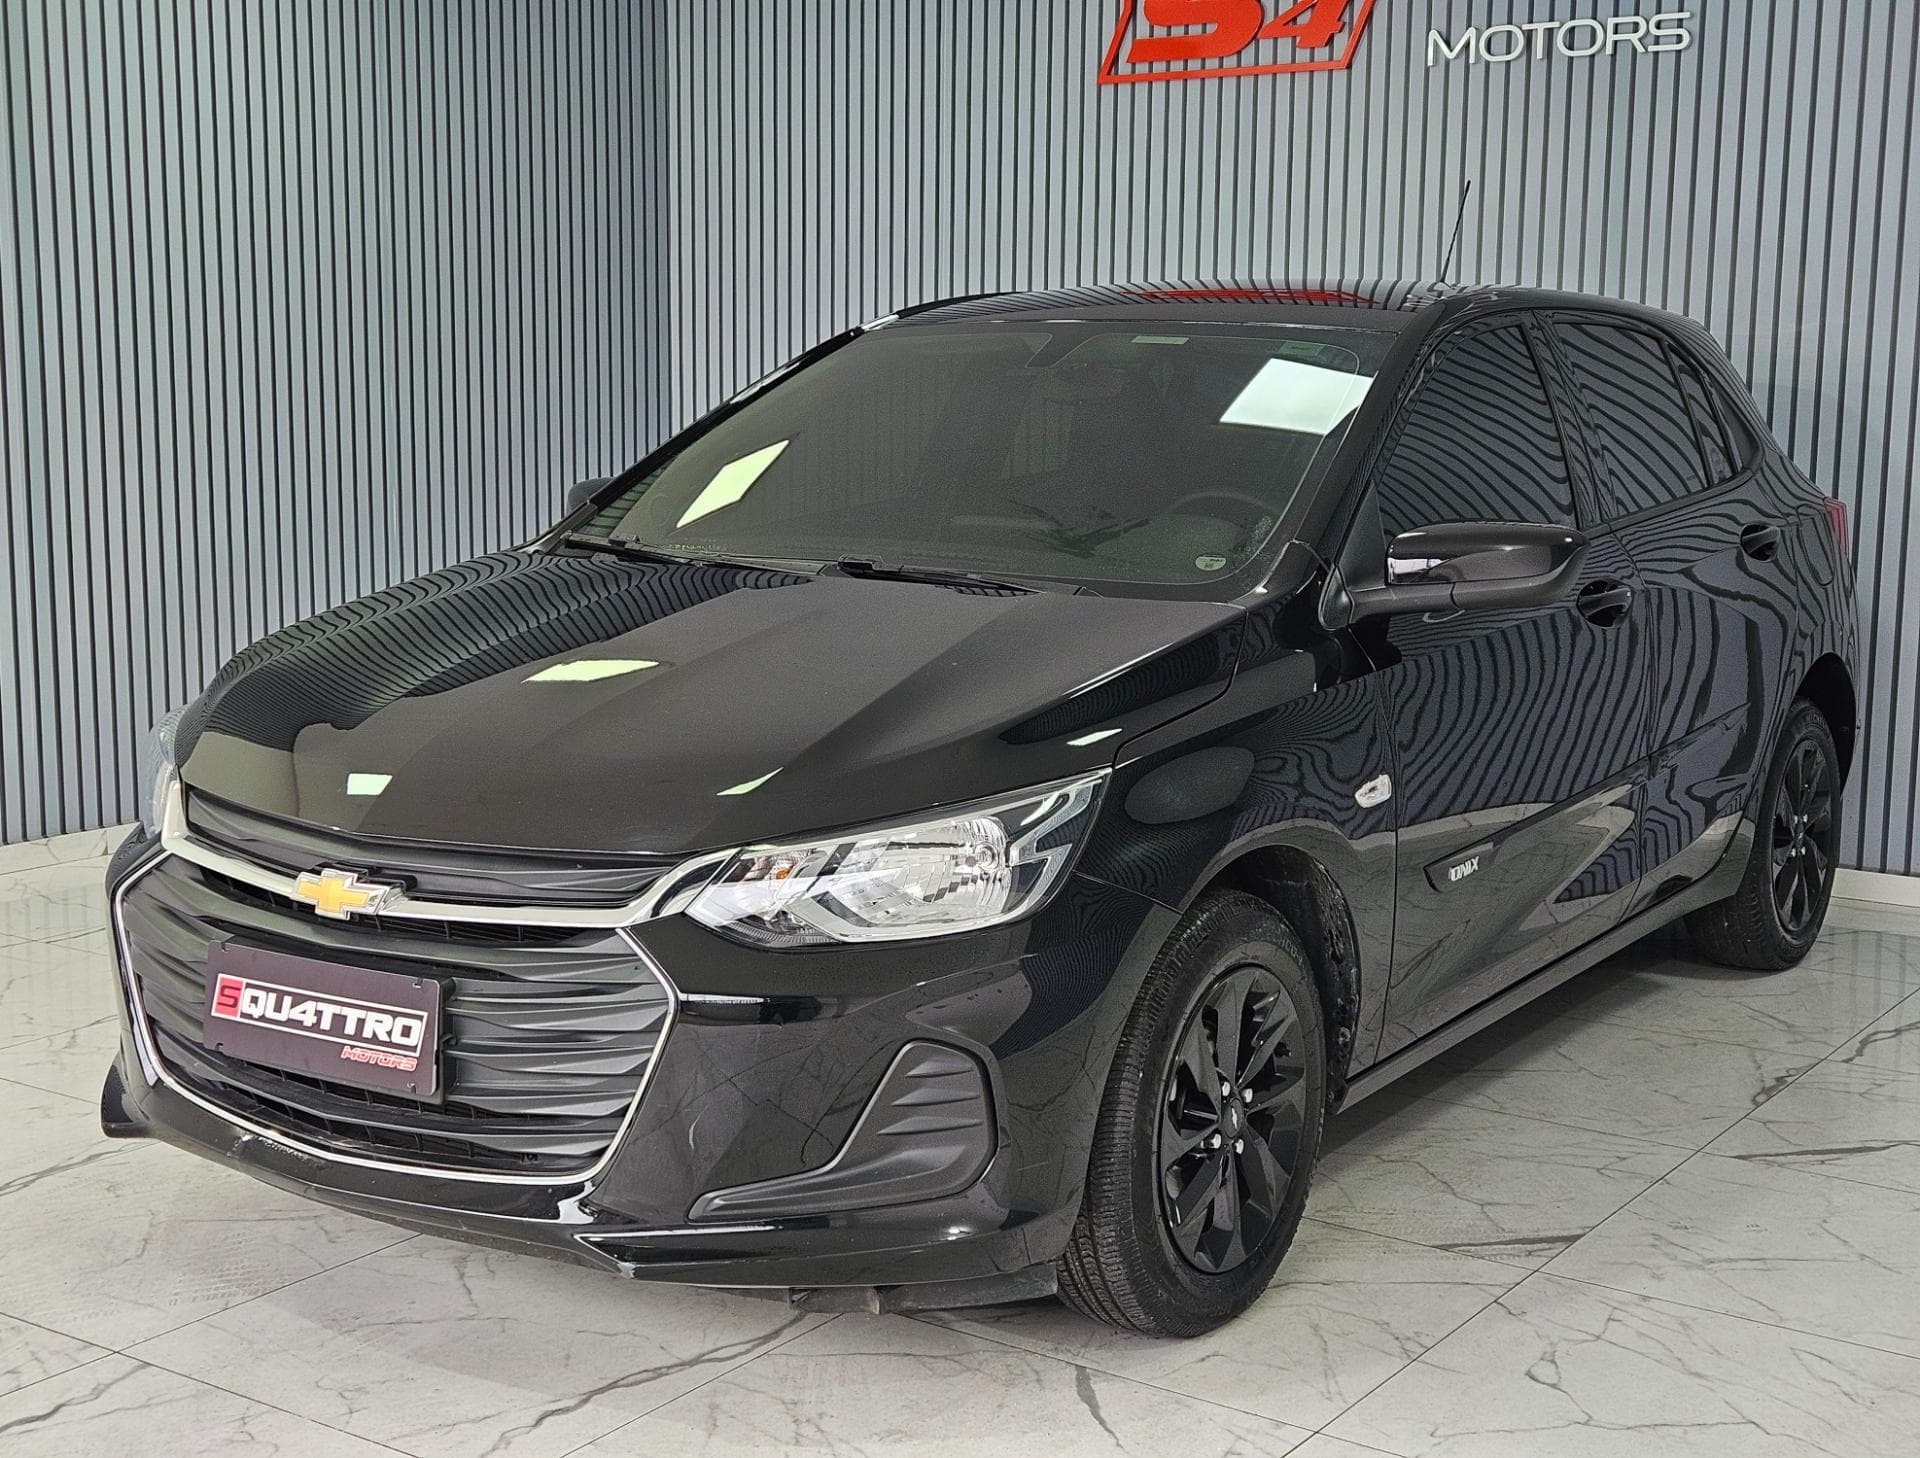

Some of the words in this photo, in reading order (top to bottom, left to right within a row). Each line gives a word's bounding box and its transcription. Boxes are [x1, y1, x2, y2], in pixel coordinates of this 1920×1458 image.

[1427, 11, 1692, 67] MOTORS
[1449, 855, 1479, 882] ONIX
[216, 985, 424, 1047] SQU4TTRO
[340, 1045, 418, 1072] MOTORS
